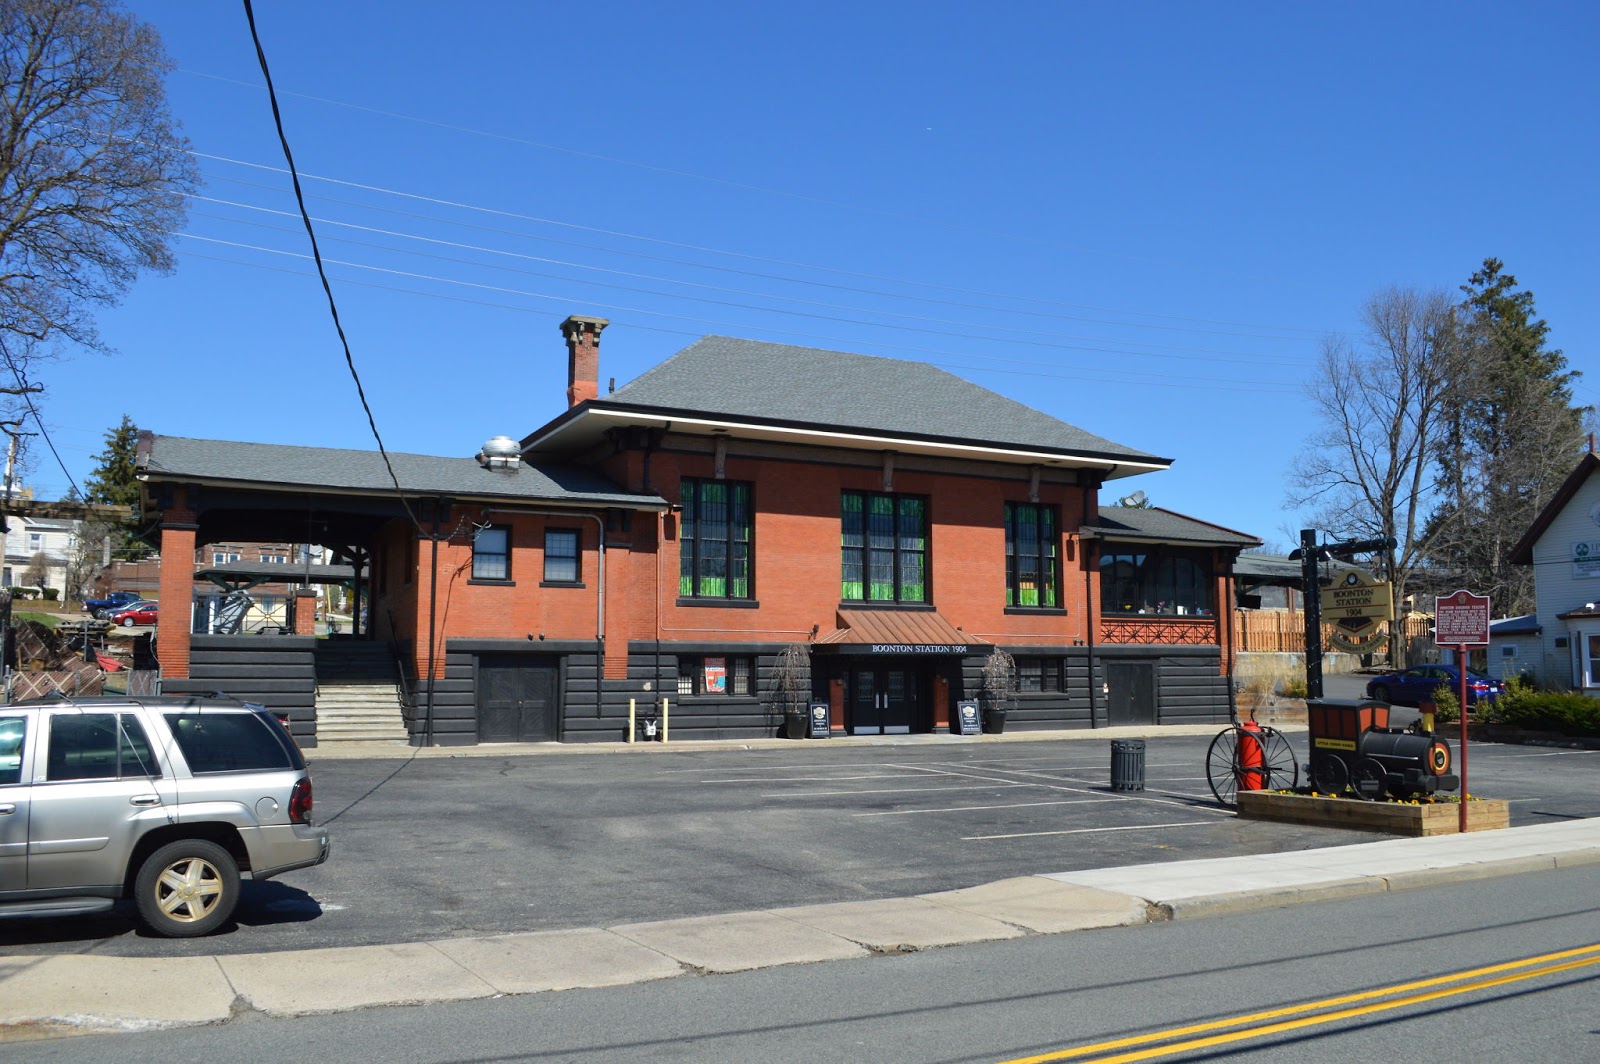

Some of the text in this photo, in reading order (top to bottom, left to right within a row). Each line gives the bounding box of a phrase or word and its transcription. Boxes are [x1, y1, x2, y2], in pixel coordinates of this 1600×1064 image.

[1333, 589, 1374, 599] BOONTON
[1336, 597, 1372, 606] STATION
[1346, 608, 1362, 616] 1904
[872, 645, 967, 653] BOONTON STATION 1904
